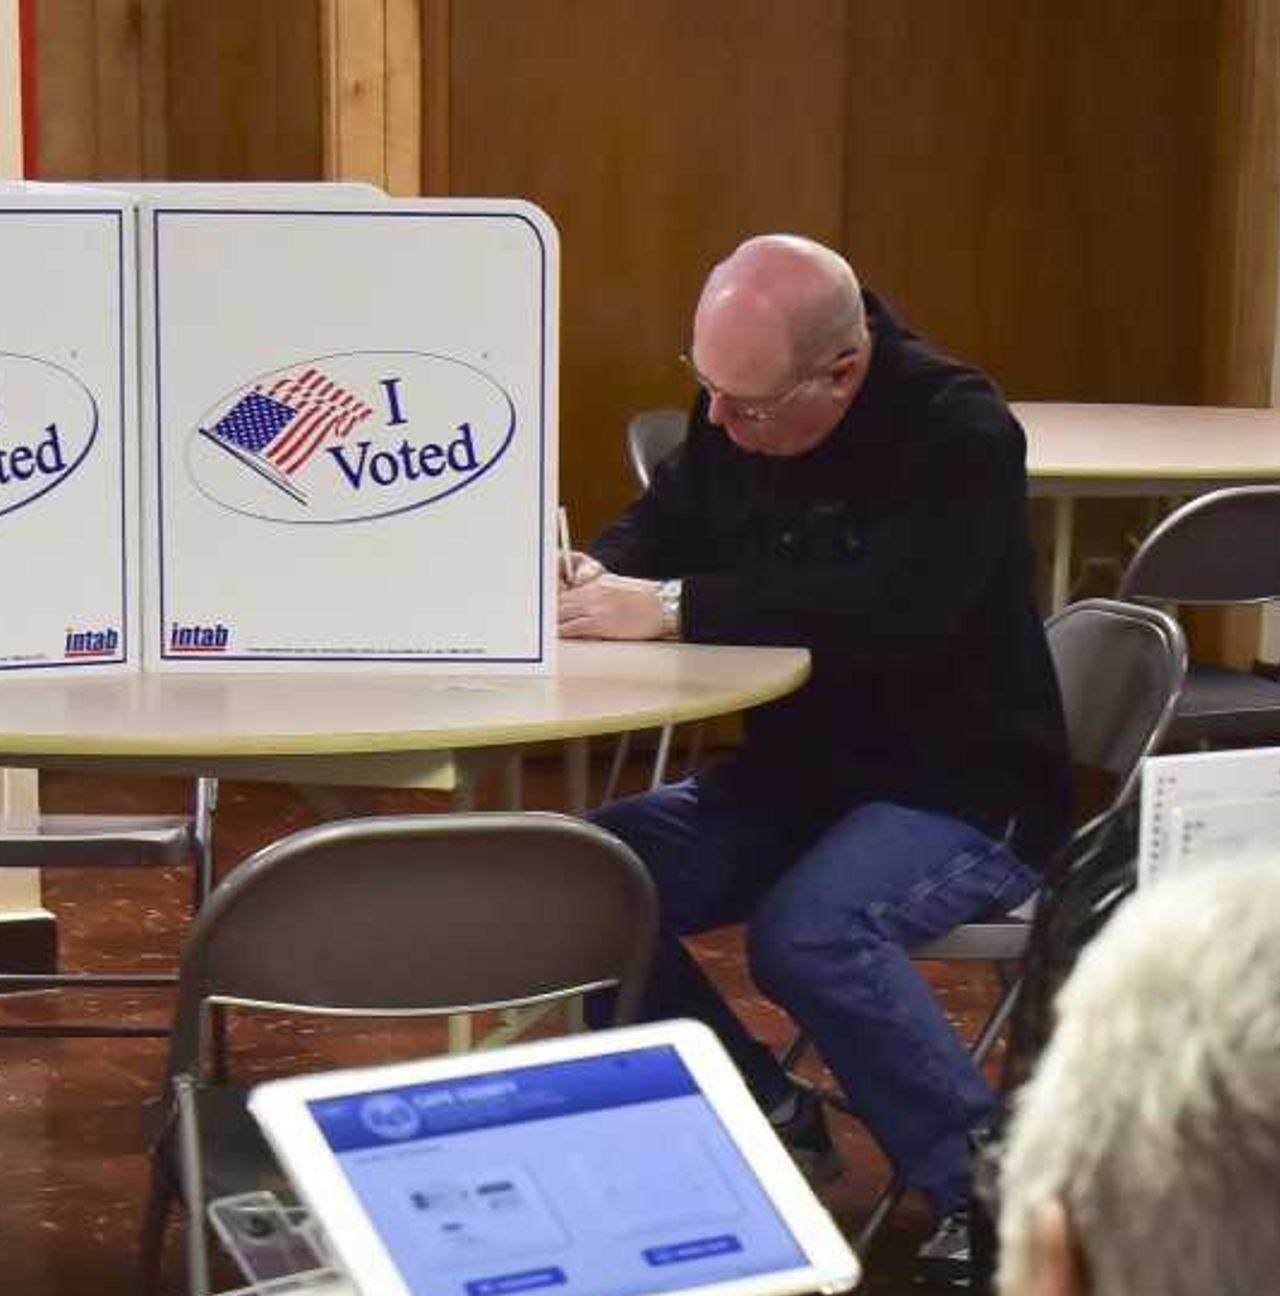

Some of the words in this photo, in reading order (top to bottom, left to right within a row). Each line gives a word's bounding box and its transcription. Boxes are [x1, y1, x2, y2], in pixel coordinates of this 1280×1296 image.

[380, 378, 408, 426] I
[325, 422, 480, 490] Voted
[64, 627, 118, 651] intab
[171, 621, 228, 646] intab
